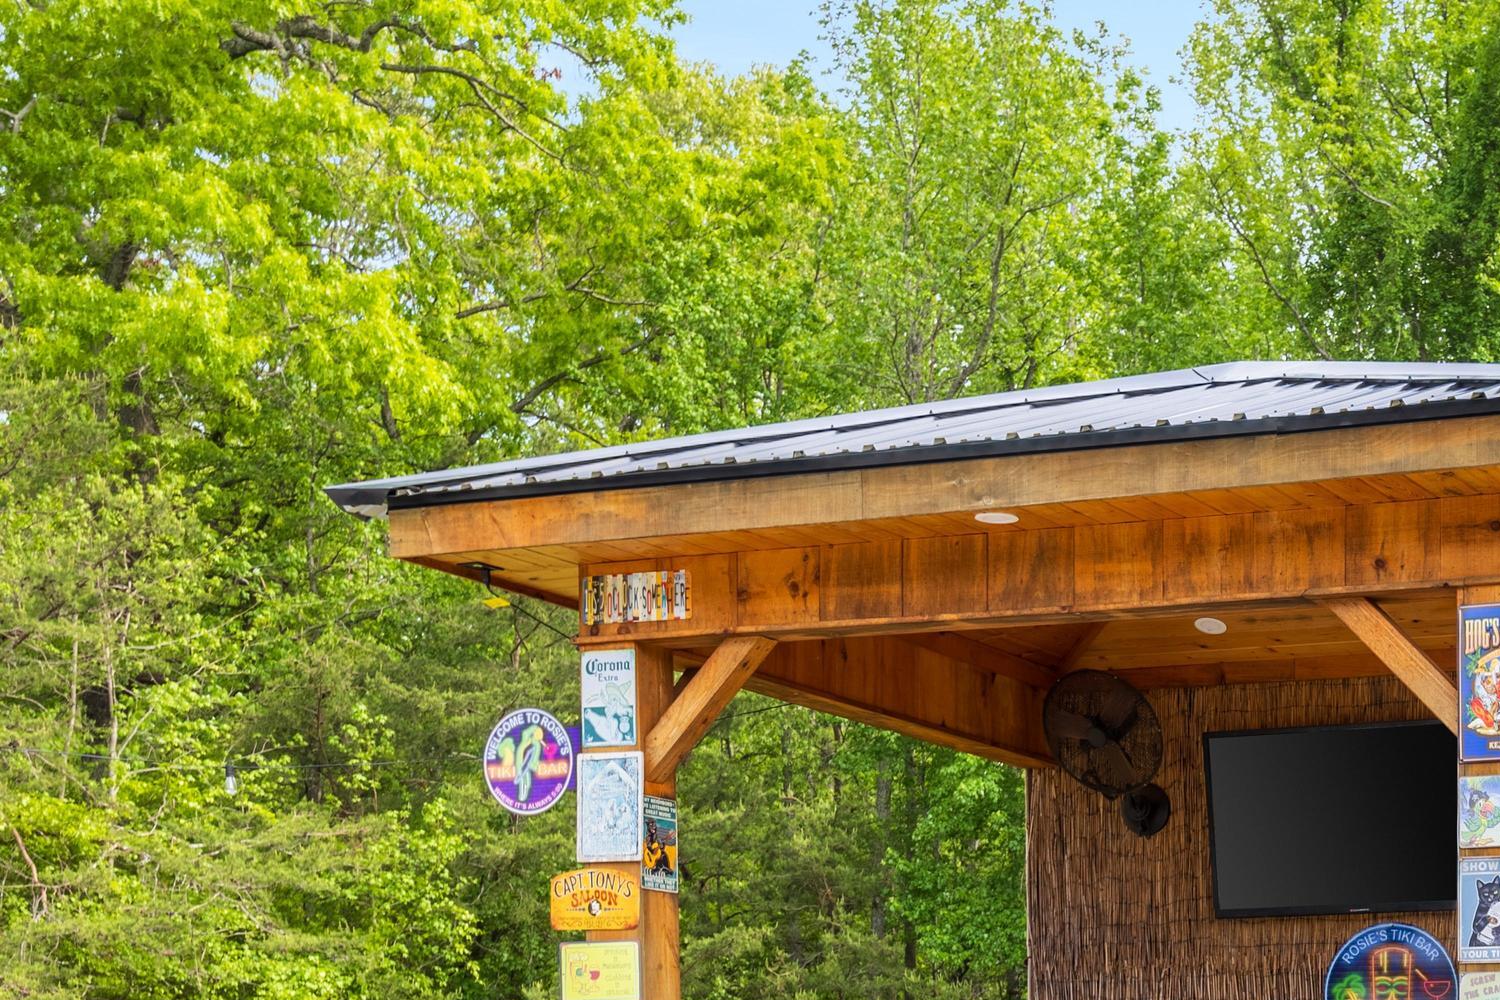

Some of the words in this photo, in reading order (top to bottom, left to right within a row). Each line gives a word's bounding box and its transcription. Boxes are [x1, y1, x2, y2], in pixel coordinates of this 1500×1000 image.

[1465, 617, 1500, 655] HOG'S
[585, 658, 630, 675] Corona
[598, 673, 619, 682] Extra
[487, 713, 525, 760] WELCOME
[525, 712, 540, 724] TO
[540, 715, 569, 756] ROSIE'S
[487, 765, 516, 779] TIKI
[537, 761, 568, 776] BAR
[514, 801, 527, 810] IT'S
[527, 794, 552, 810] ALWAYS
[1462, 861, 1499, 872] SHOW
[571, 889, 618, 908] SALOON
[1341, 930, 1388, 964] ROSIE'S
[1390, 929, 1414, 943] TIKI
[1414, 936, 1440, 961] BAR
[1462, 950, 1489, 958] YOUR
[1470, 974, 1496, 987] SCREW
[1464, 989, 1479, 1000] THE
